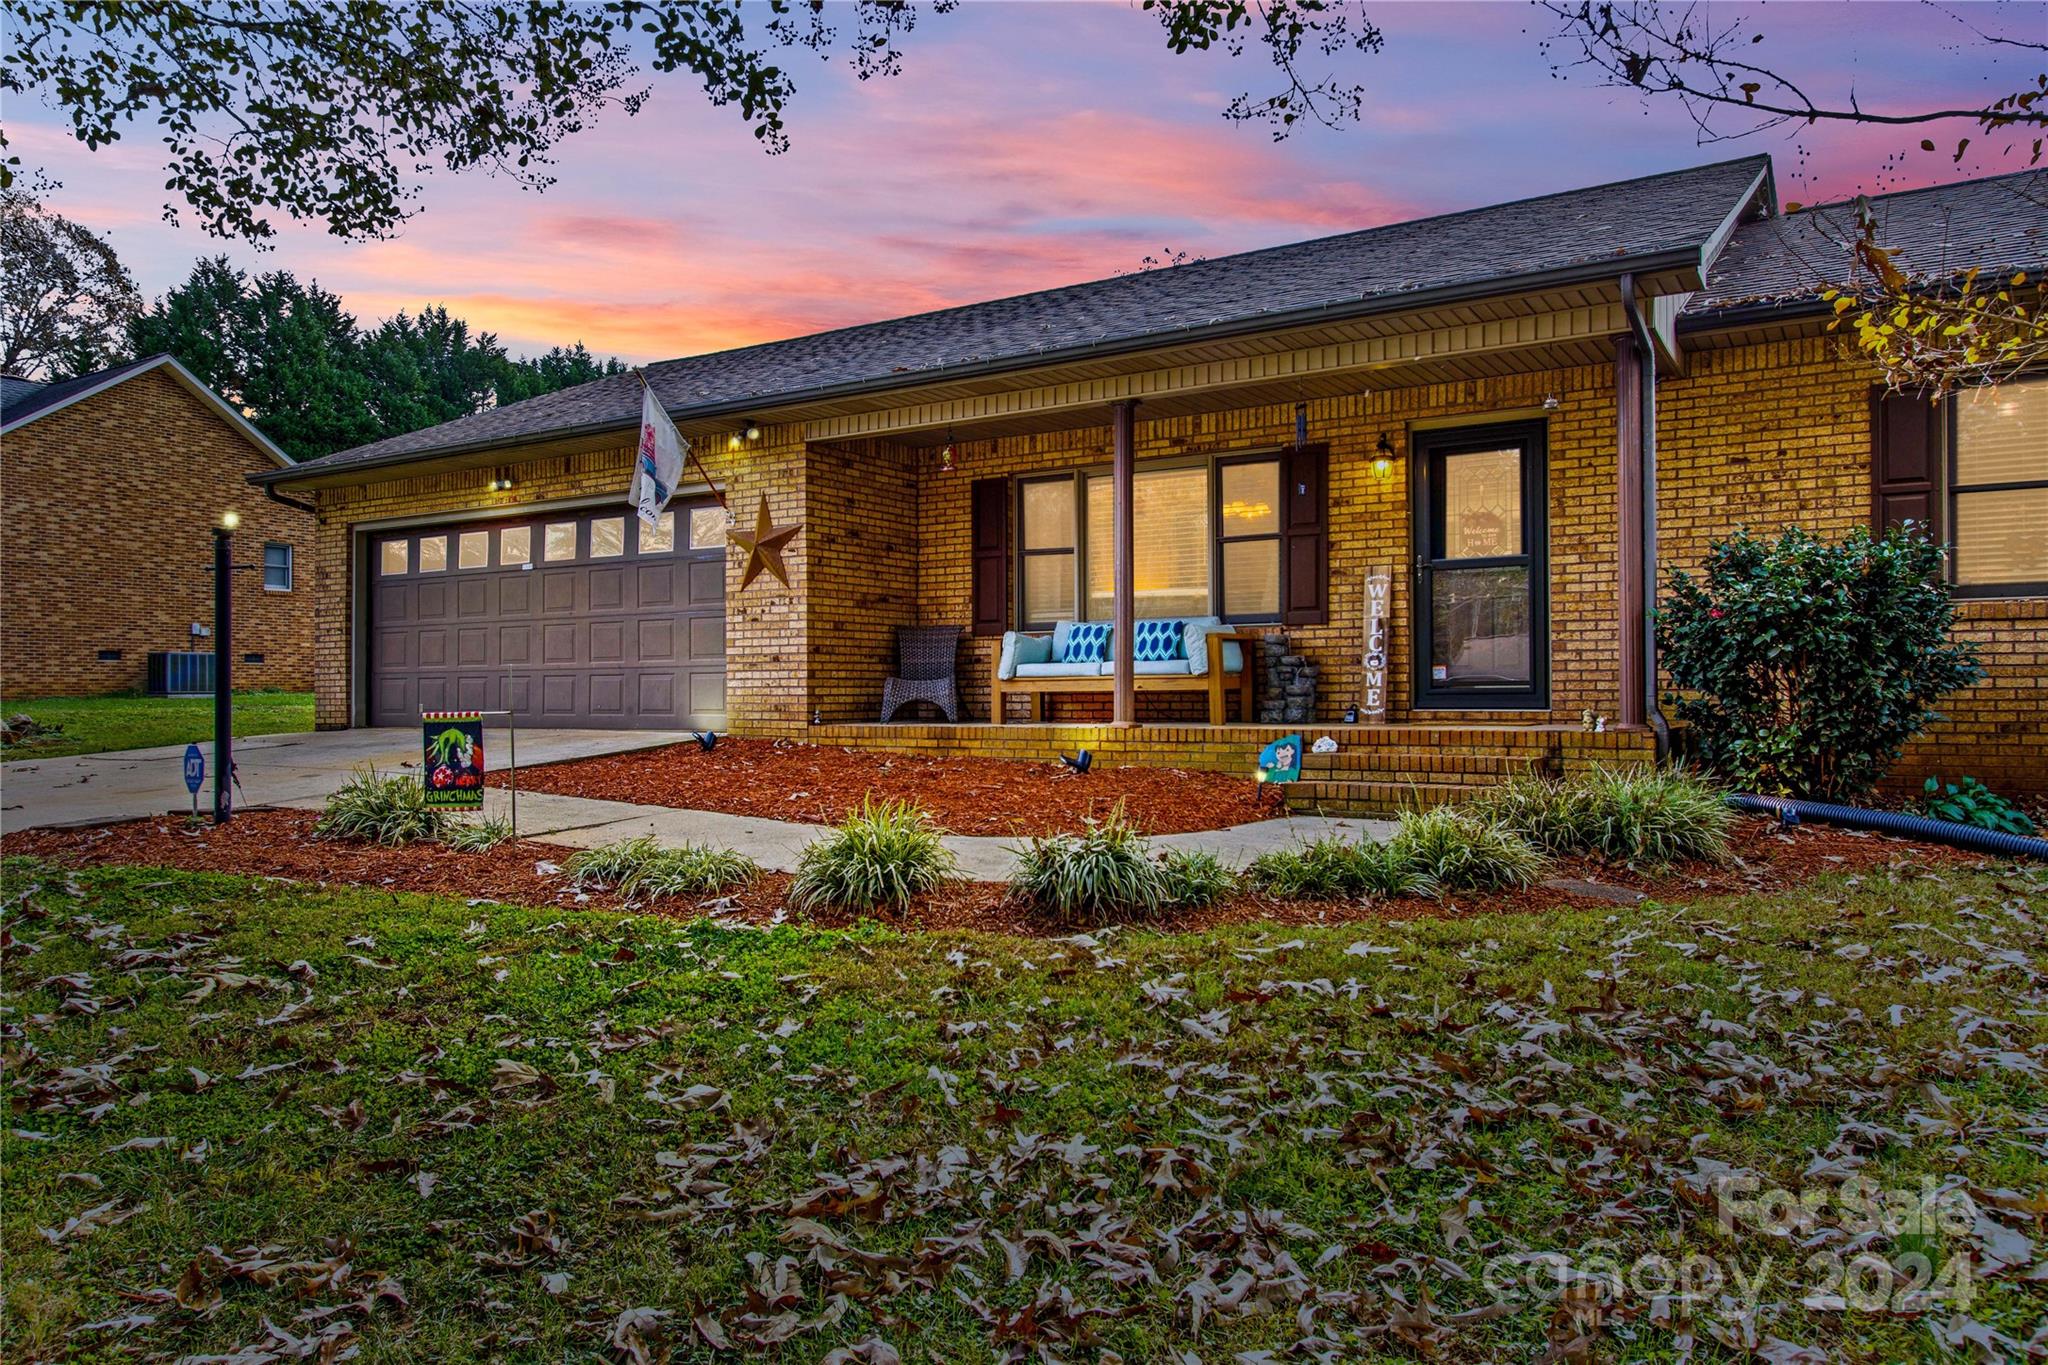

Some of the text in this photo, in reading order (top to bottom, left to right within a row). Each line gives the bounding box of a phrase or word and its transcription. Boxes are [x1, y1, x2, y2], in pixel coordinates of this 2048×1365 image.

[1464, 526, 1499, 535] Welcome
[1364, 583, 1389, 706] WELCOME
[186, 759, 202, 777] ADT
[426, 789, 483, 802] GRINCHMAS
